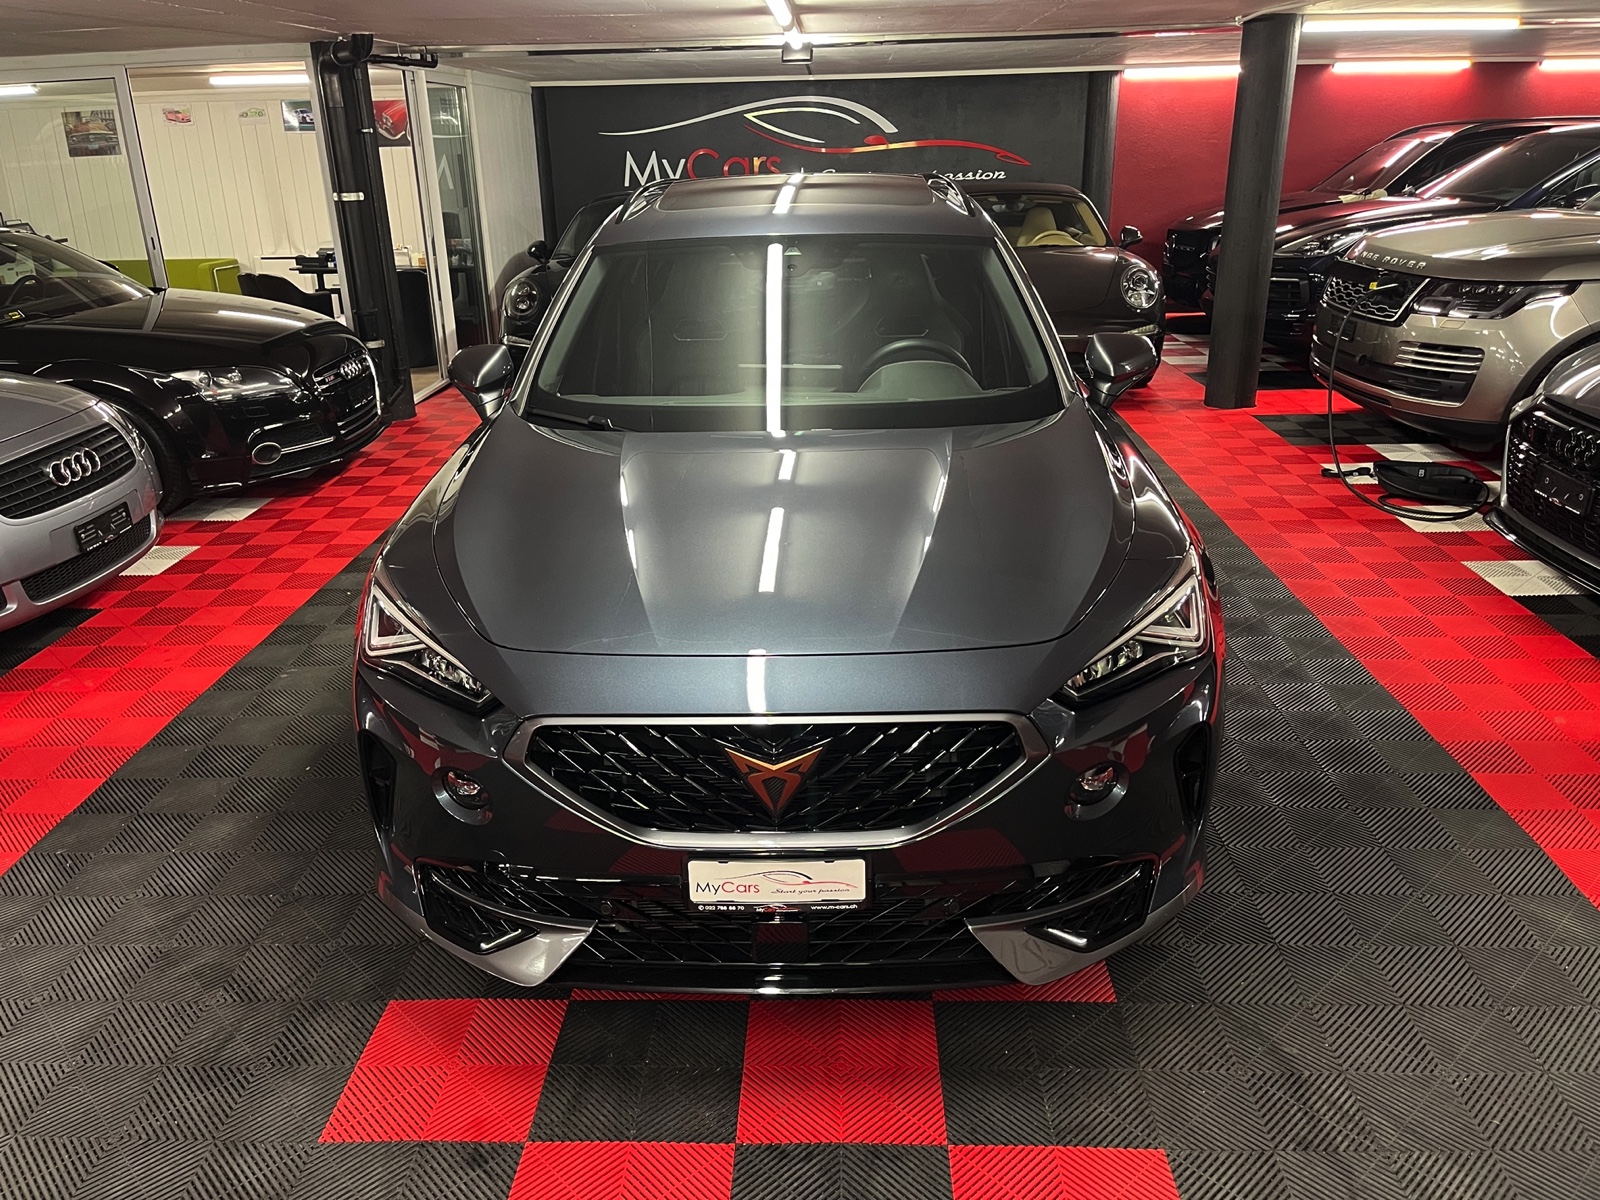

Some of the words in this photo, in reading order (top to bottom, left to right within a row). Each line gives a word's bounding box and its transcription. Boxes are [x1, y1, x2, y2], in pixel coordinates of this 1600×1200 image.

[1382, 256, 1427, 269] ROVER
[695, 881, 760, 896] MyCars
[797, 888, 817, 896] your
